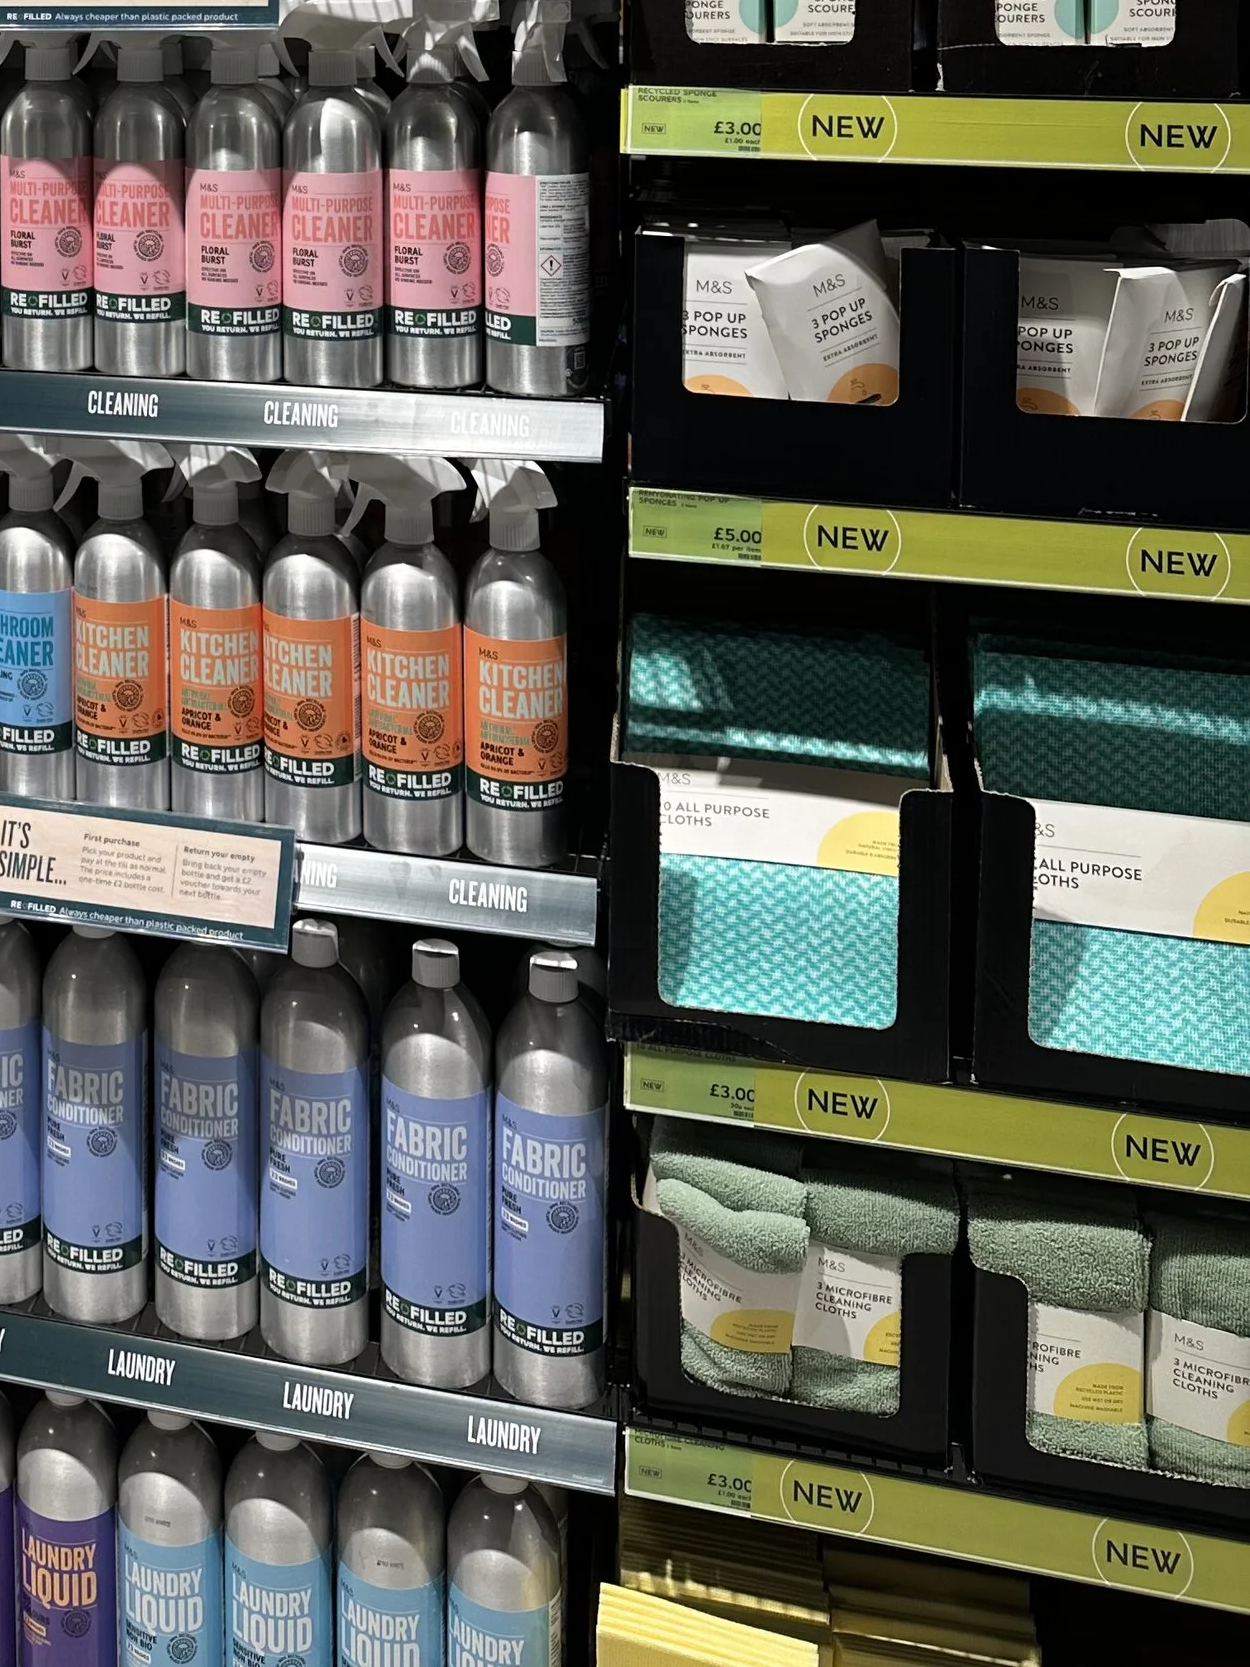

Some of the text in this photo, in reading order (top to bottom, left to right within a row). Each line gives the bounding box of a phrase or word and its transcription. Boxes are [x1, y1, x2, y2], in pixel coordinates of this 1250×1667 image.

[55, 13, 83, 22] Always
[85, 13, 118, 22] cheaper
[142, 12, 169, 22] plastic
[171, 12, 202, 22] packed
[204, 13, 238, 22] product
[638, 88, 716, 98] RECYCLED SPONGE
[638, 96, 682, 104] SCOURERS
[714, 122, 761, 136] £3.00
[812, 115, 884, 138] NEW
[1141, 124, 1217, 148] NEW
[292, 195, 373, 214] MULTI-PURPOSE
[292, 216, 373, 243] CLEANER
[201, 245, 229, 256] FLORAL
[201, 255, 226, 265] BURST
[696, 280, 733, 294] M&S
[811, 298, 866, 329] 3 POP UP
[815, 311, 872, 343] SPONGES
[823, 334, 878, 362] EXTRA ABSORBENT
[1144, 351, 1198, 367] SPONGES
[264, 402, 338, 427] CLEANING
[639, 497, 677, 507] SPONGES
[714, 528, 762, 544] £5.00
[818, 525, 889, 552] NEW
[367, 648, 449, 680] KITCHEN
[367, 678, 449, 711] CLEANER
[480, 742, 514, 756] APRICOT
[480, 751, 514, 765] ORANGE
[1039, 858, 1142, 881] ALL PURPOSE
[449, 879, 527, 912] CLEANING
[808, 1088, 878, 1119] NEW
[502, 1126, 586, 1178] FABRIC
[502, 1165, 586, 1200] CONDITIONER
[818, 1257, 846, 1273] M&S
[816, 1292, 872, 1312] CLEANING
[817, 1282, 893, 1305] 3 MICROFIBRE
[815, 1302, 857, 1319] CLOTHS
[1174, 1333, 1204, 1351] M&S
[283, 1381, 354, 1420] LAUNDRY
[468, 1416, 541, 1455] LAUNDRY
[708, 1473, 752, 1492] £3.00
[793, 1481, 862, 1512] NEW
[21, 1528, 96, 1570] LAUNDRY
[1106, 1540, 1180, 1574] NEW
[22, 1556, 97, 1609] LIQUID
